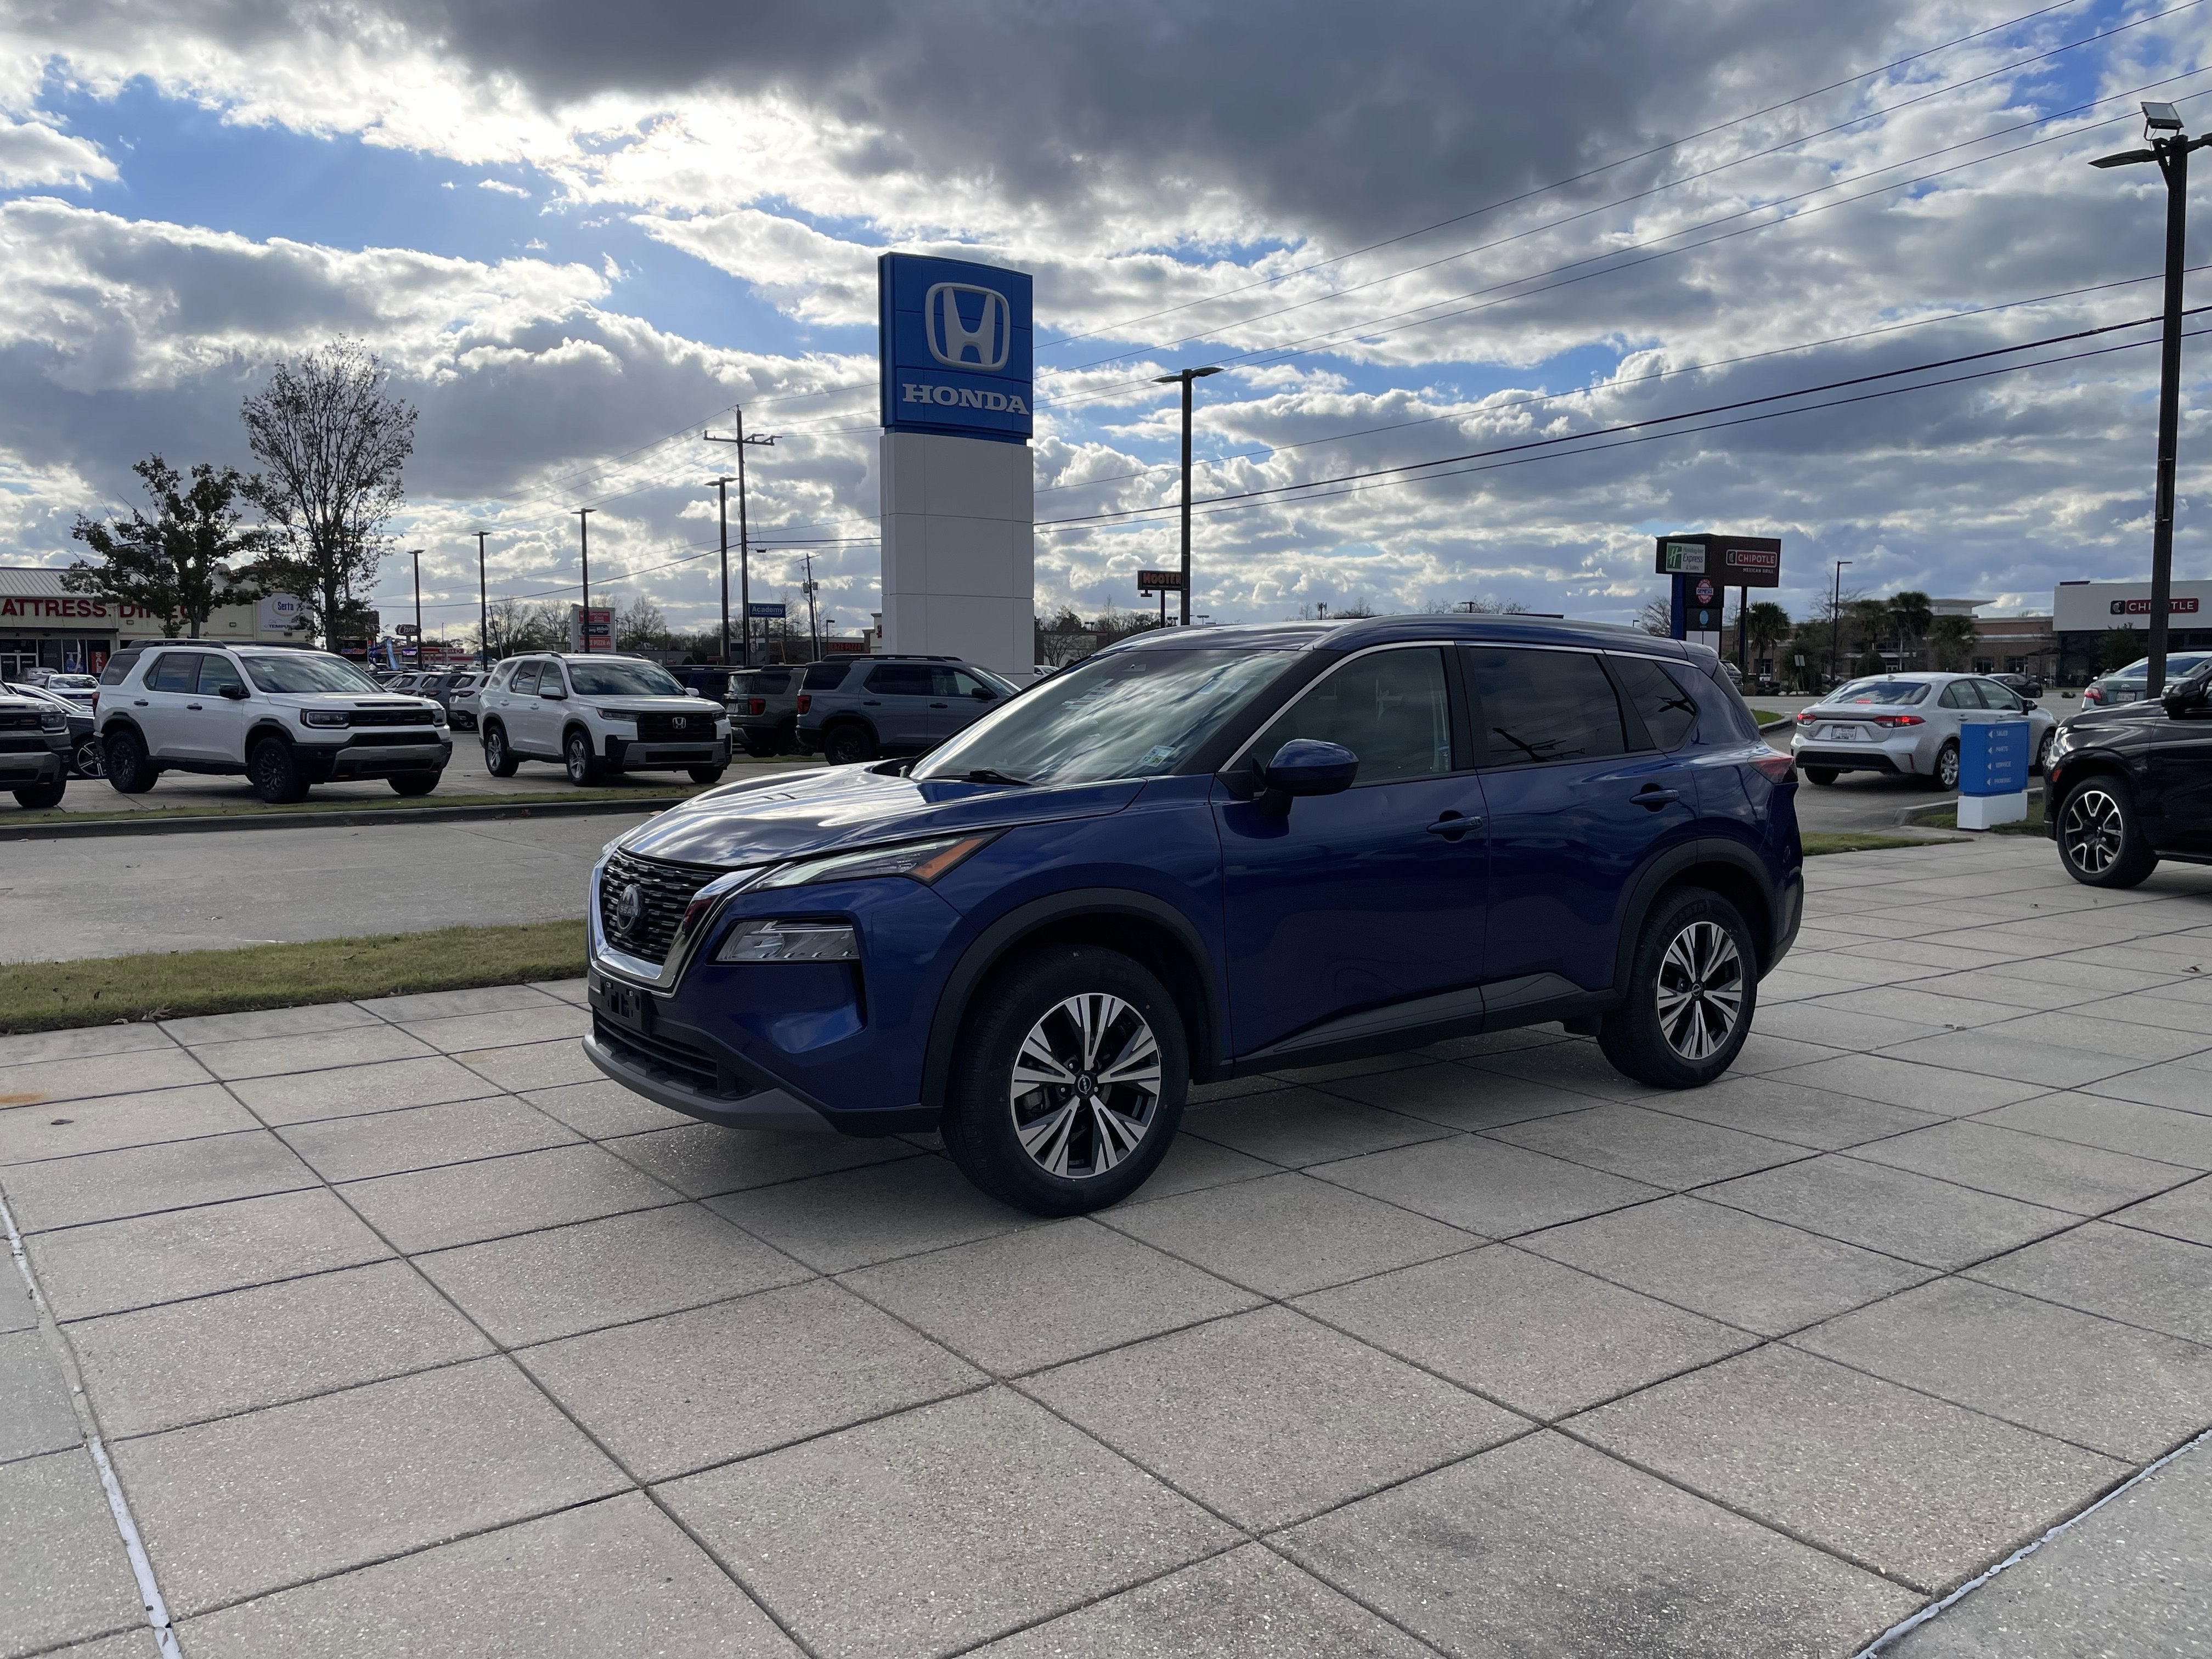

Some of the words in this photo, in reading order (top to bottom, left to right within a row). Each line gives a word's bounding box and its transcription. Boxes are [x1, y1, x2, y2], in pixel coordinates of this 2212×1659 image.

[902, 383, 1030, 415] HONDA
[1683, 553, 1703, 564] Express
[1738, 554, 1775, 564] CHIPOTLE
[278, 601, 294, 611] Serta
[752, 606, 783, 615] Academy
[2129, 601, 2194, 611] CHITLE
